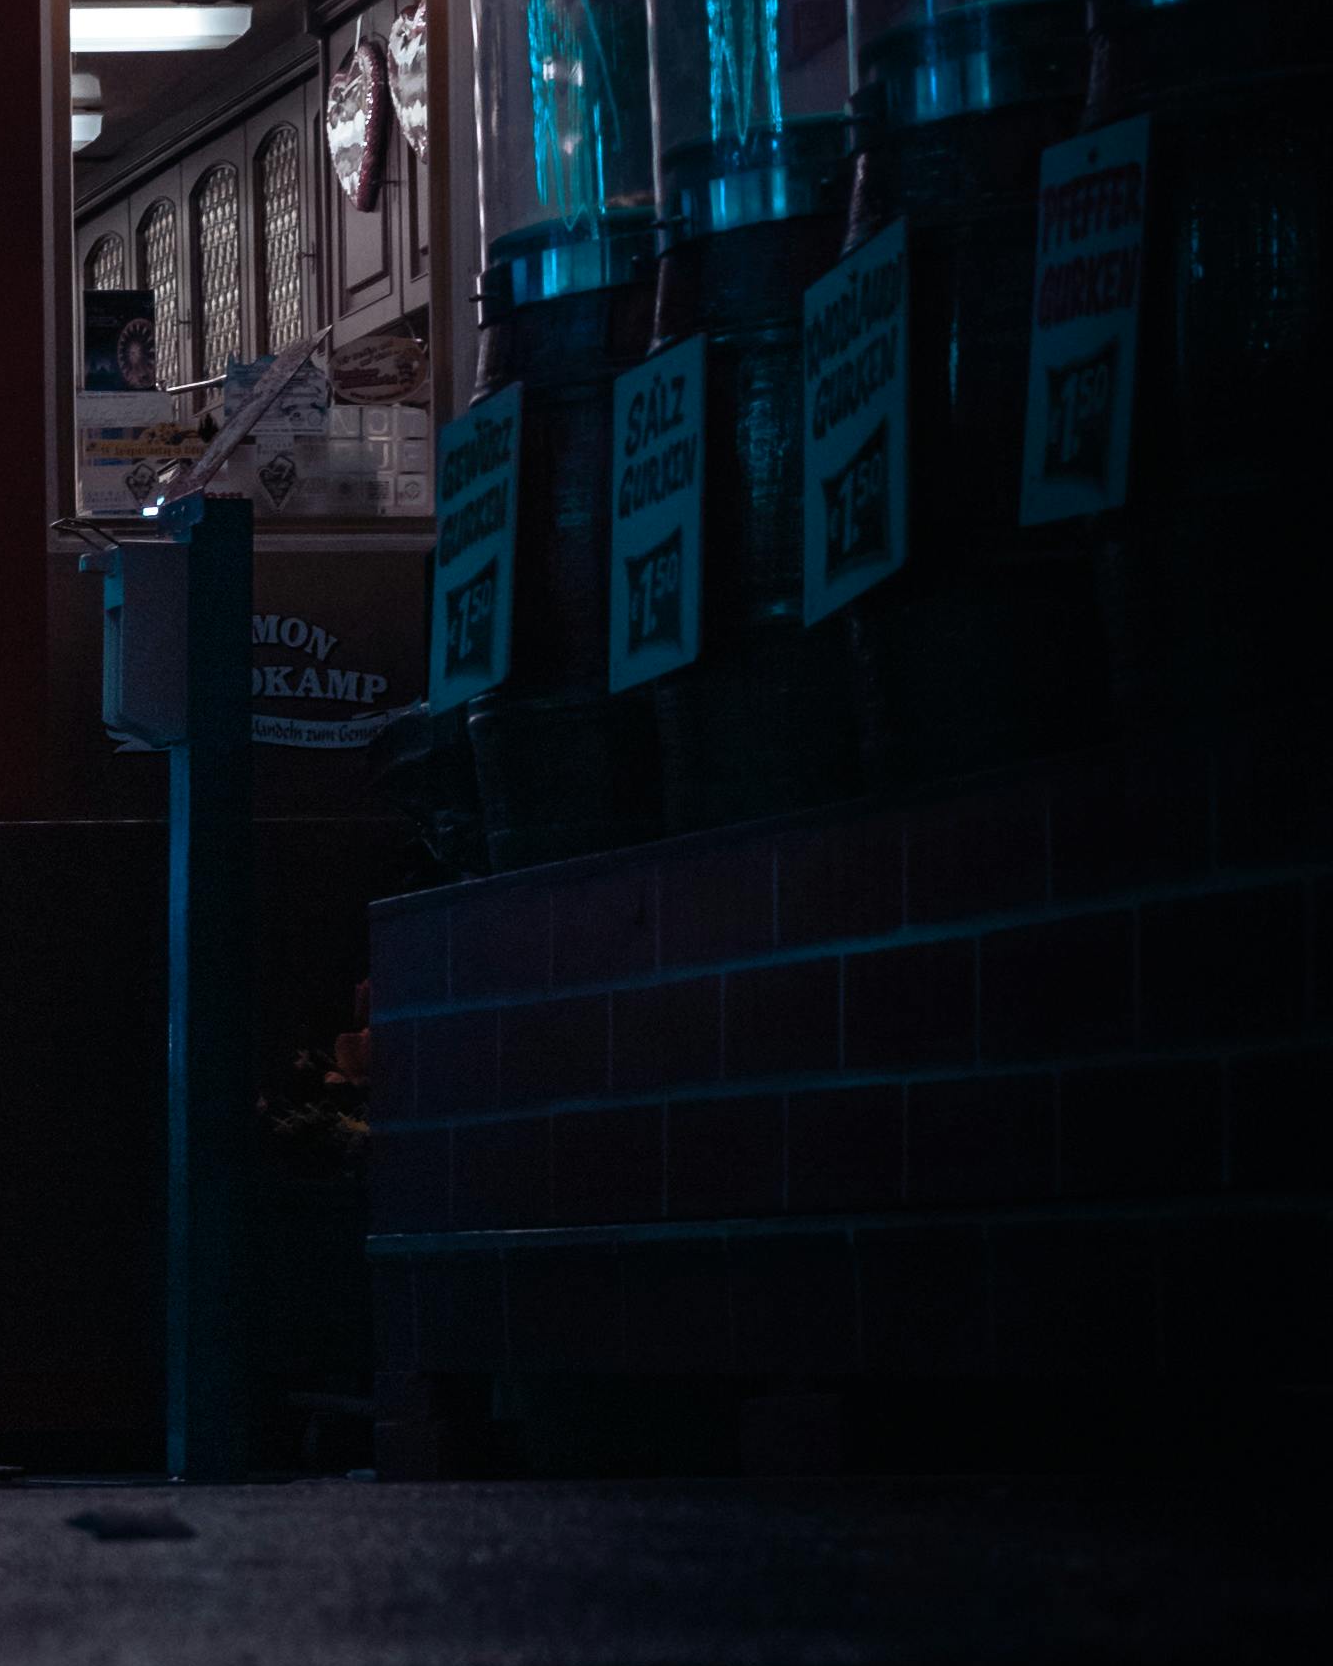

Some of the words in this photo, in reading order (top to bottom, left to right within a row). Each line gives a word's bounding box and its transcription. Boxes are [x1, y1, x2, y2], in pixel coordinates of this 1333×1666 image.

[1039, 246, 1139, 328] GURKEN
[812, 330, 897, 439] GURKEN
[618, 438, 697, 518] GURKEN
